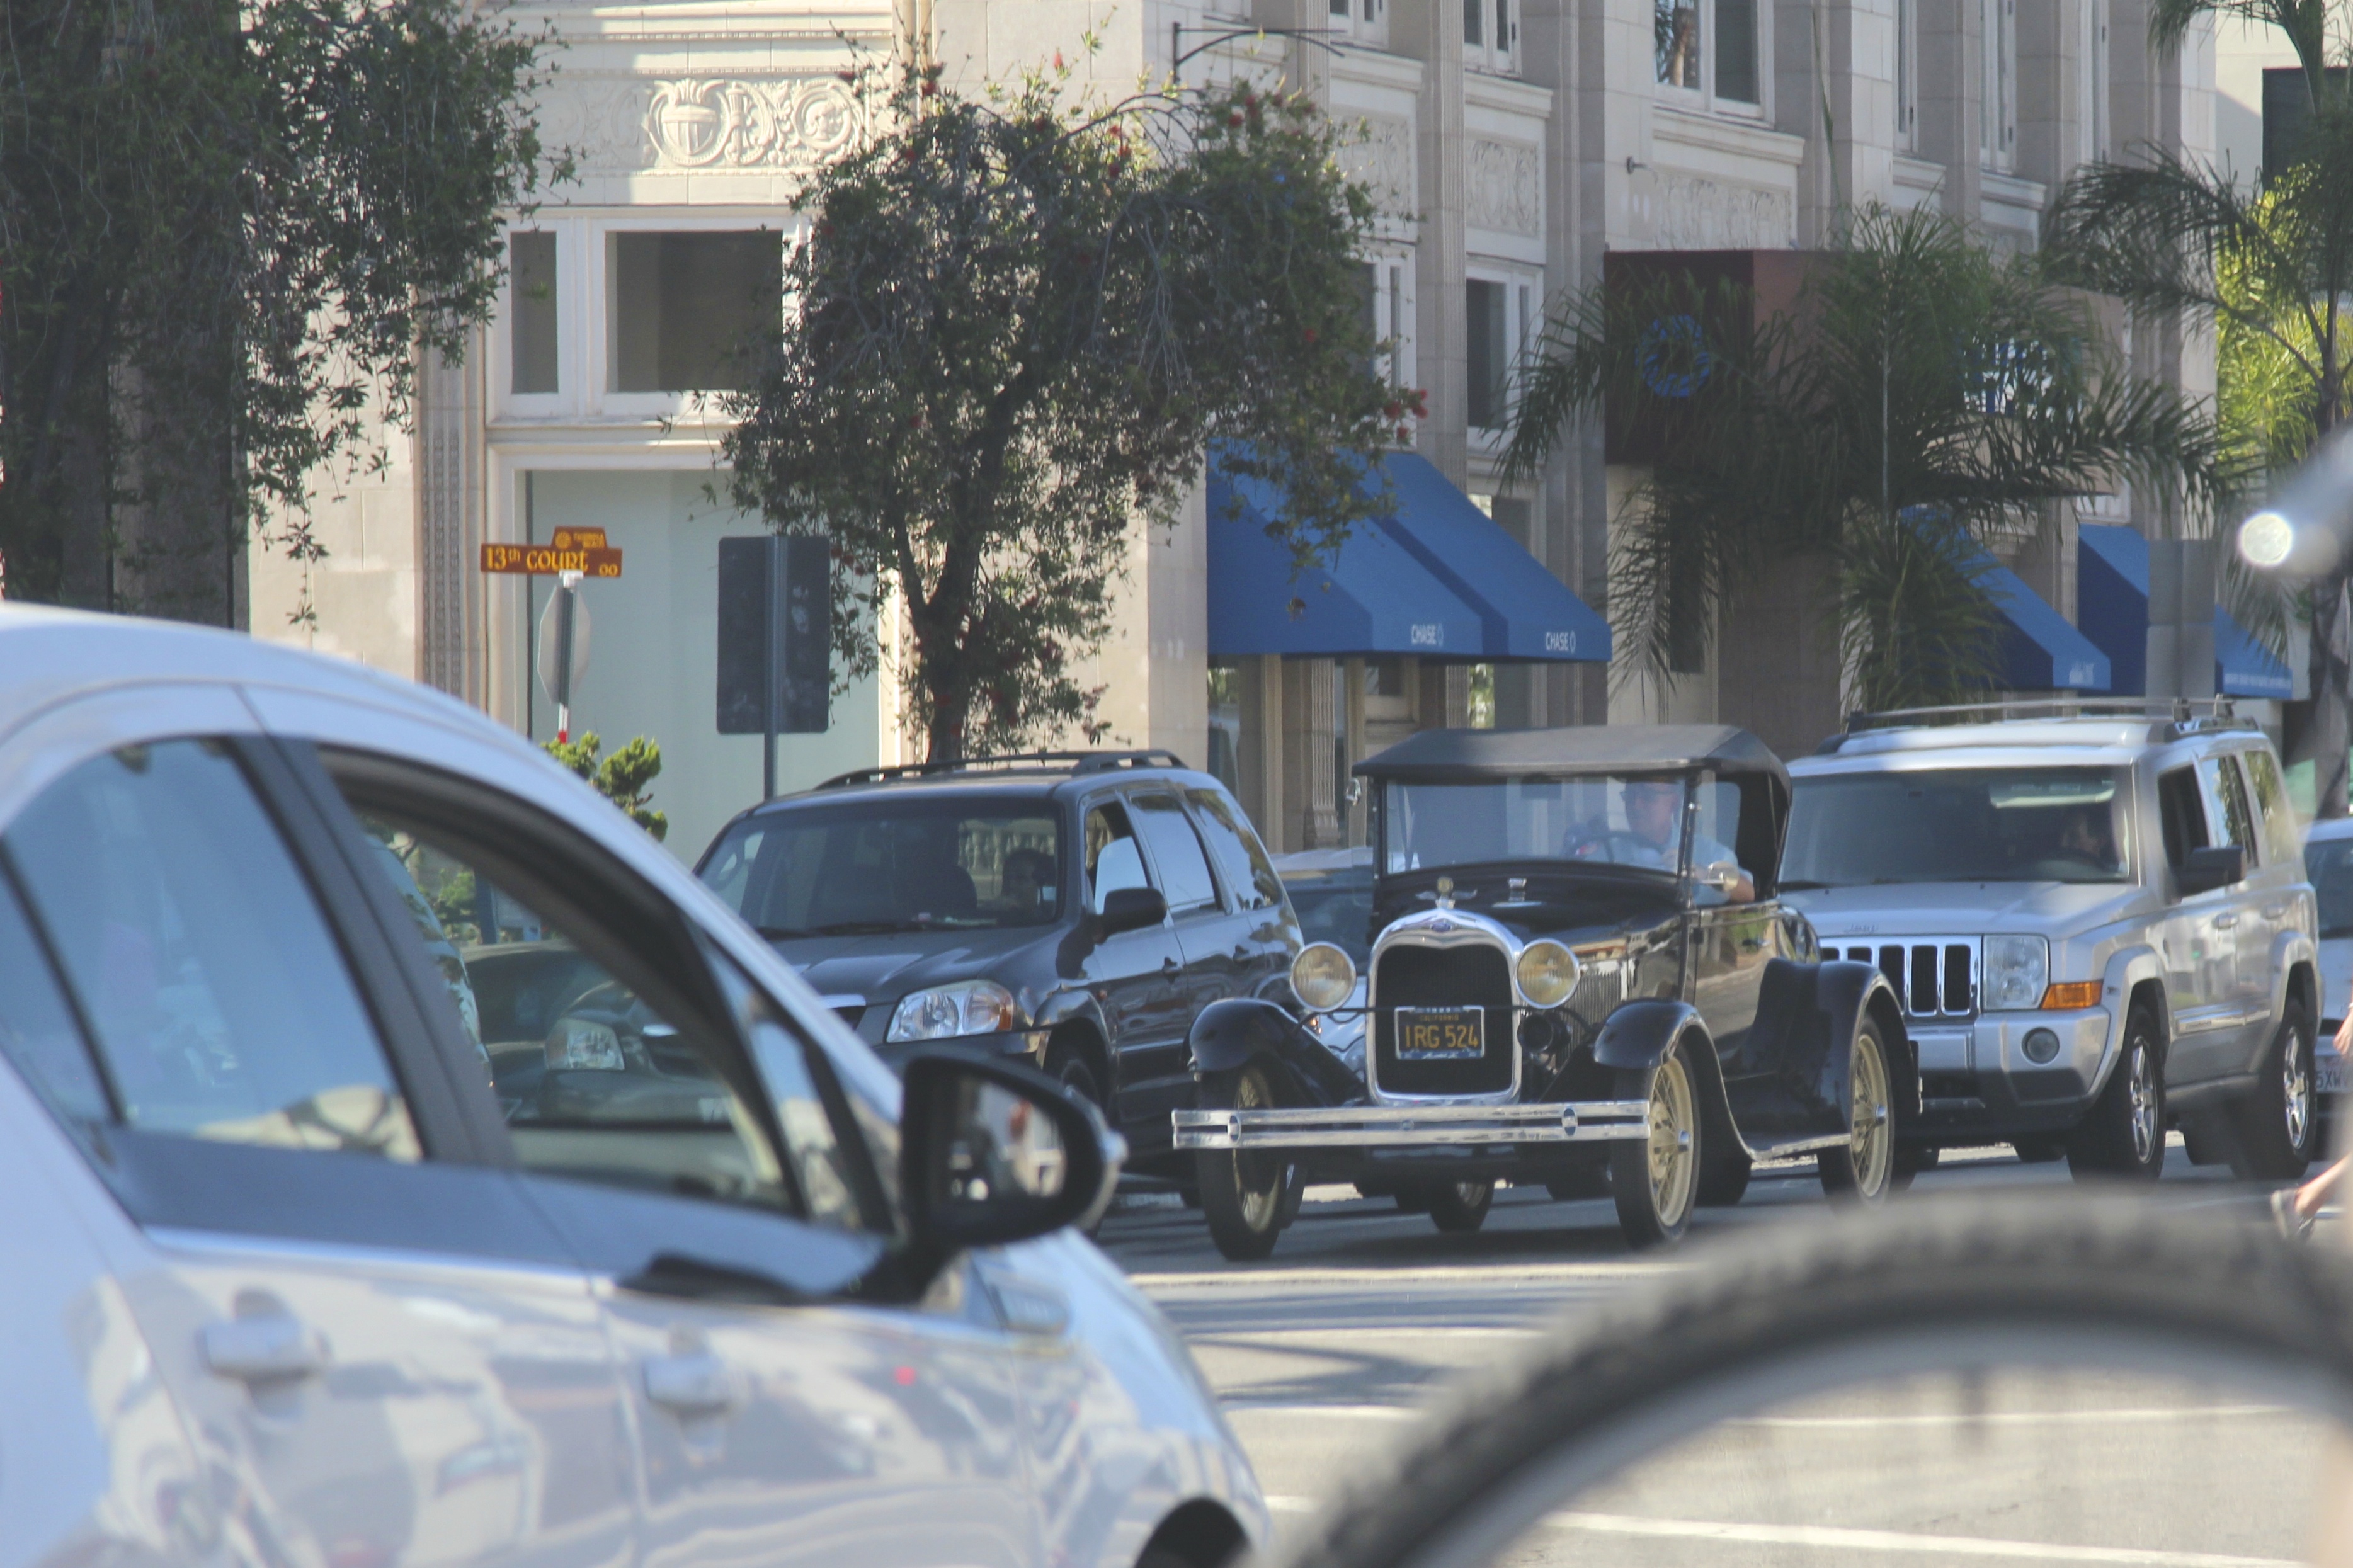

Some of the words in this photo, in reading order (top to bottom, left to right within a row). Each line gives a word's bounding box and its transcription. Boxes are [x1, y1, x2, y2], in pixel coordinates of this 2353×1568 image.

[486, 547, 521, 570] 13th
[1411, 623, 1437, 644] CHASE
[1546, 631, 1570, 651] CHASE
[1445, 1024, 1479, 1048] 524
